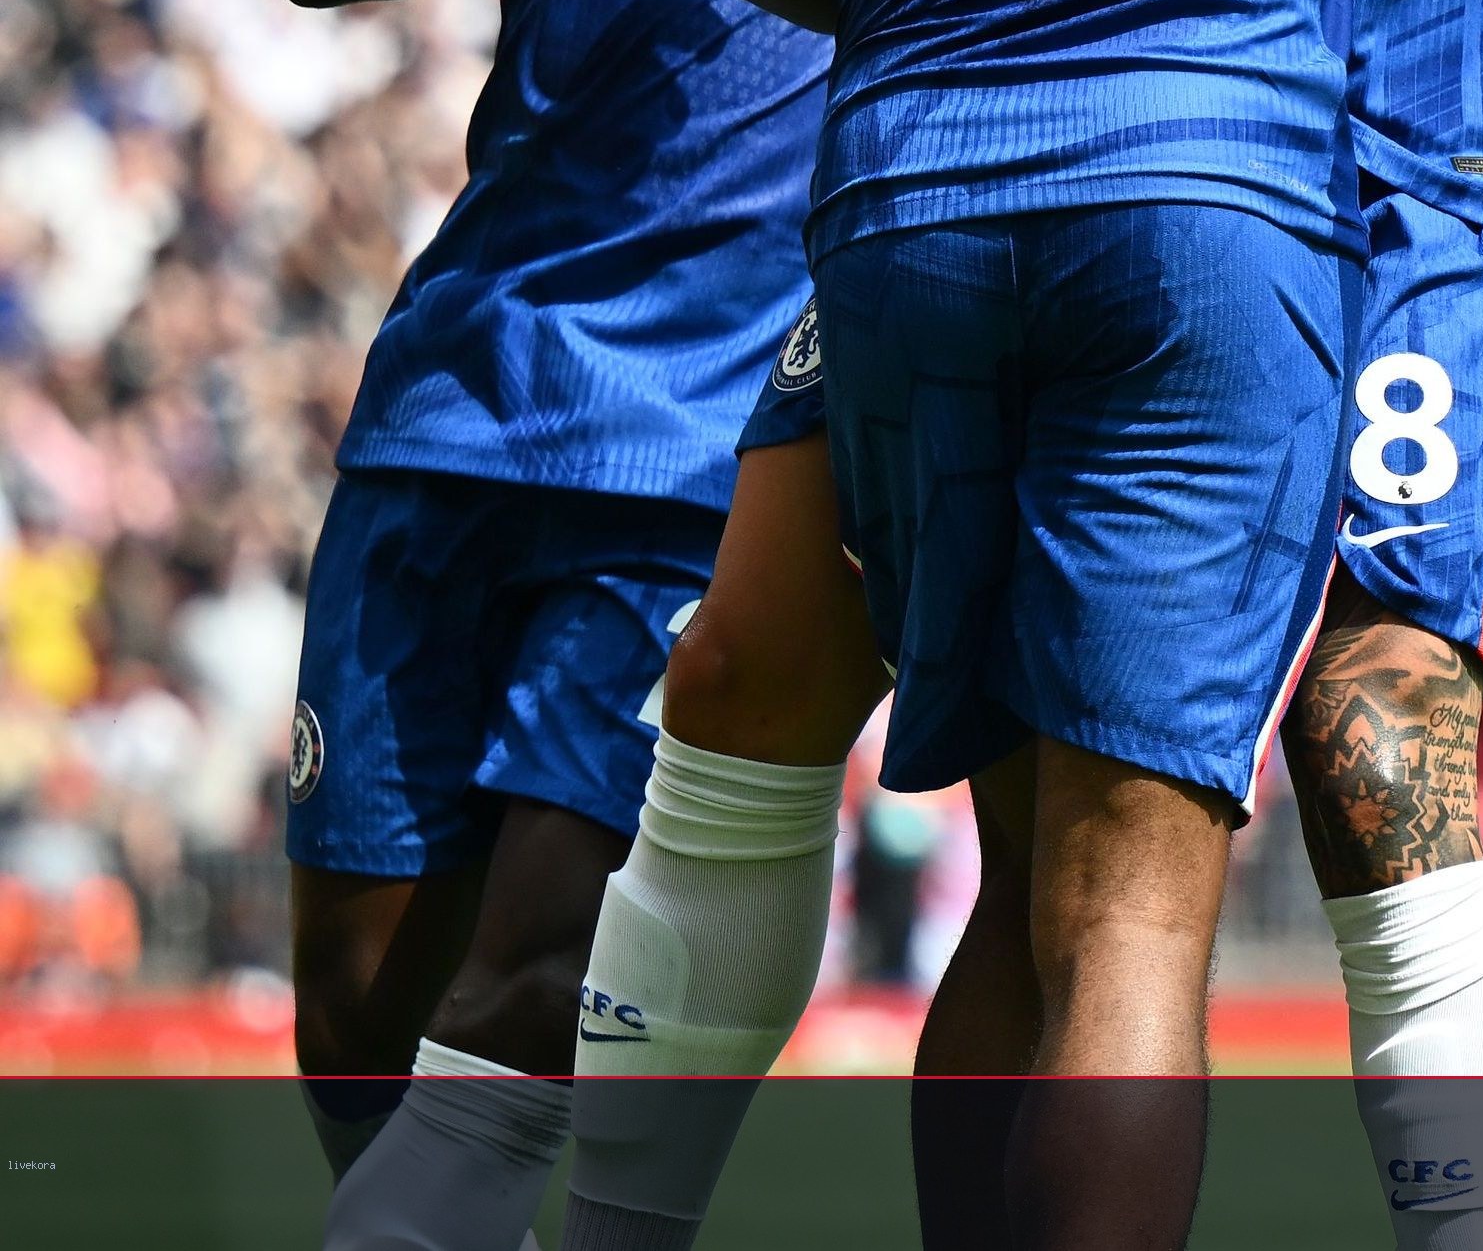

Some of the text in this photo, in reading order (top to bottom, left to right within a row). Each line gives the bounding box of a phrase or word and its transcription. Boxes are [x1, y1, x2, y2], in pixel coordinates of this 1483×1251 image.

[1350, 352, 1458, 505] 8
[581, 985, 646, 1030] CFC
[1388, 1159, 1474, 1183] CFC
